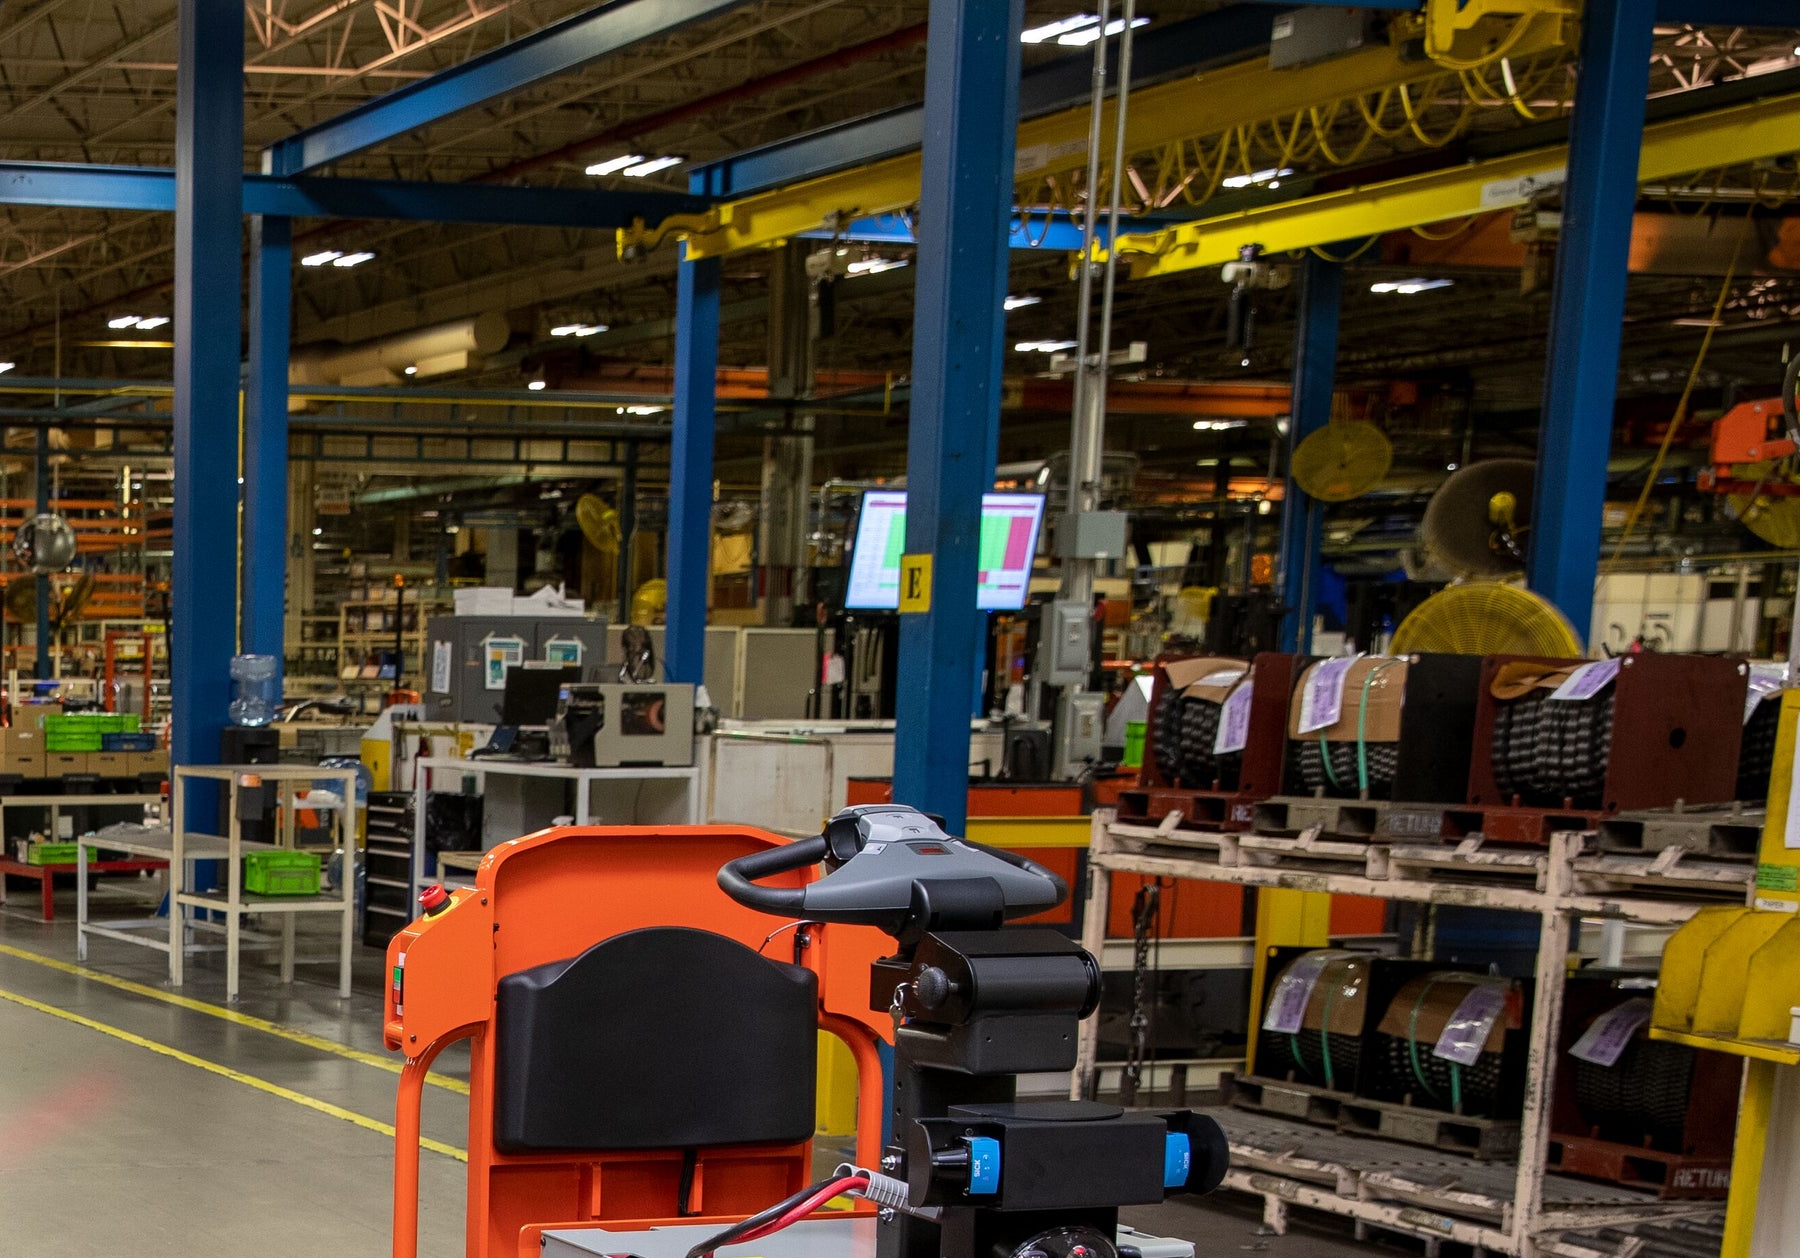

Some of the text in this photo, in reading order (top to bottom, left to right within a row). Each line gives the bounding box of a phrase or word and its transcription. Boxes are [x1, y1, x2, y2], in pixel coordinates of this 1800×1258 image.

[907, 567, 921, 599] E
[974, 1159, 982, 1178] SICK
[1674, 1169, 1730, 1188] RETUR
